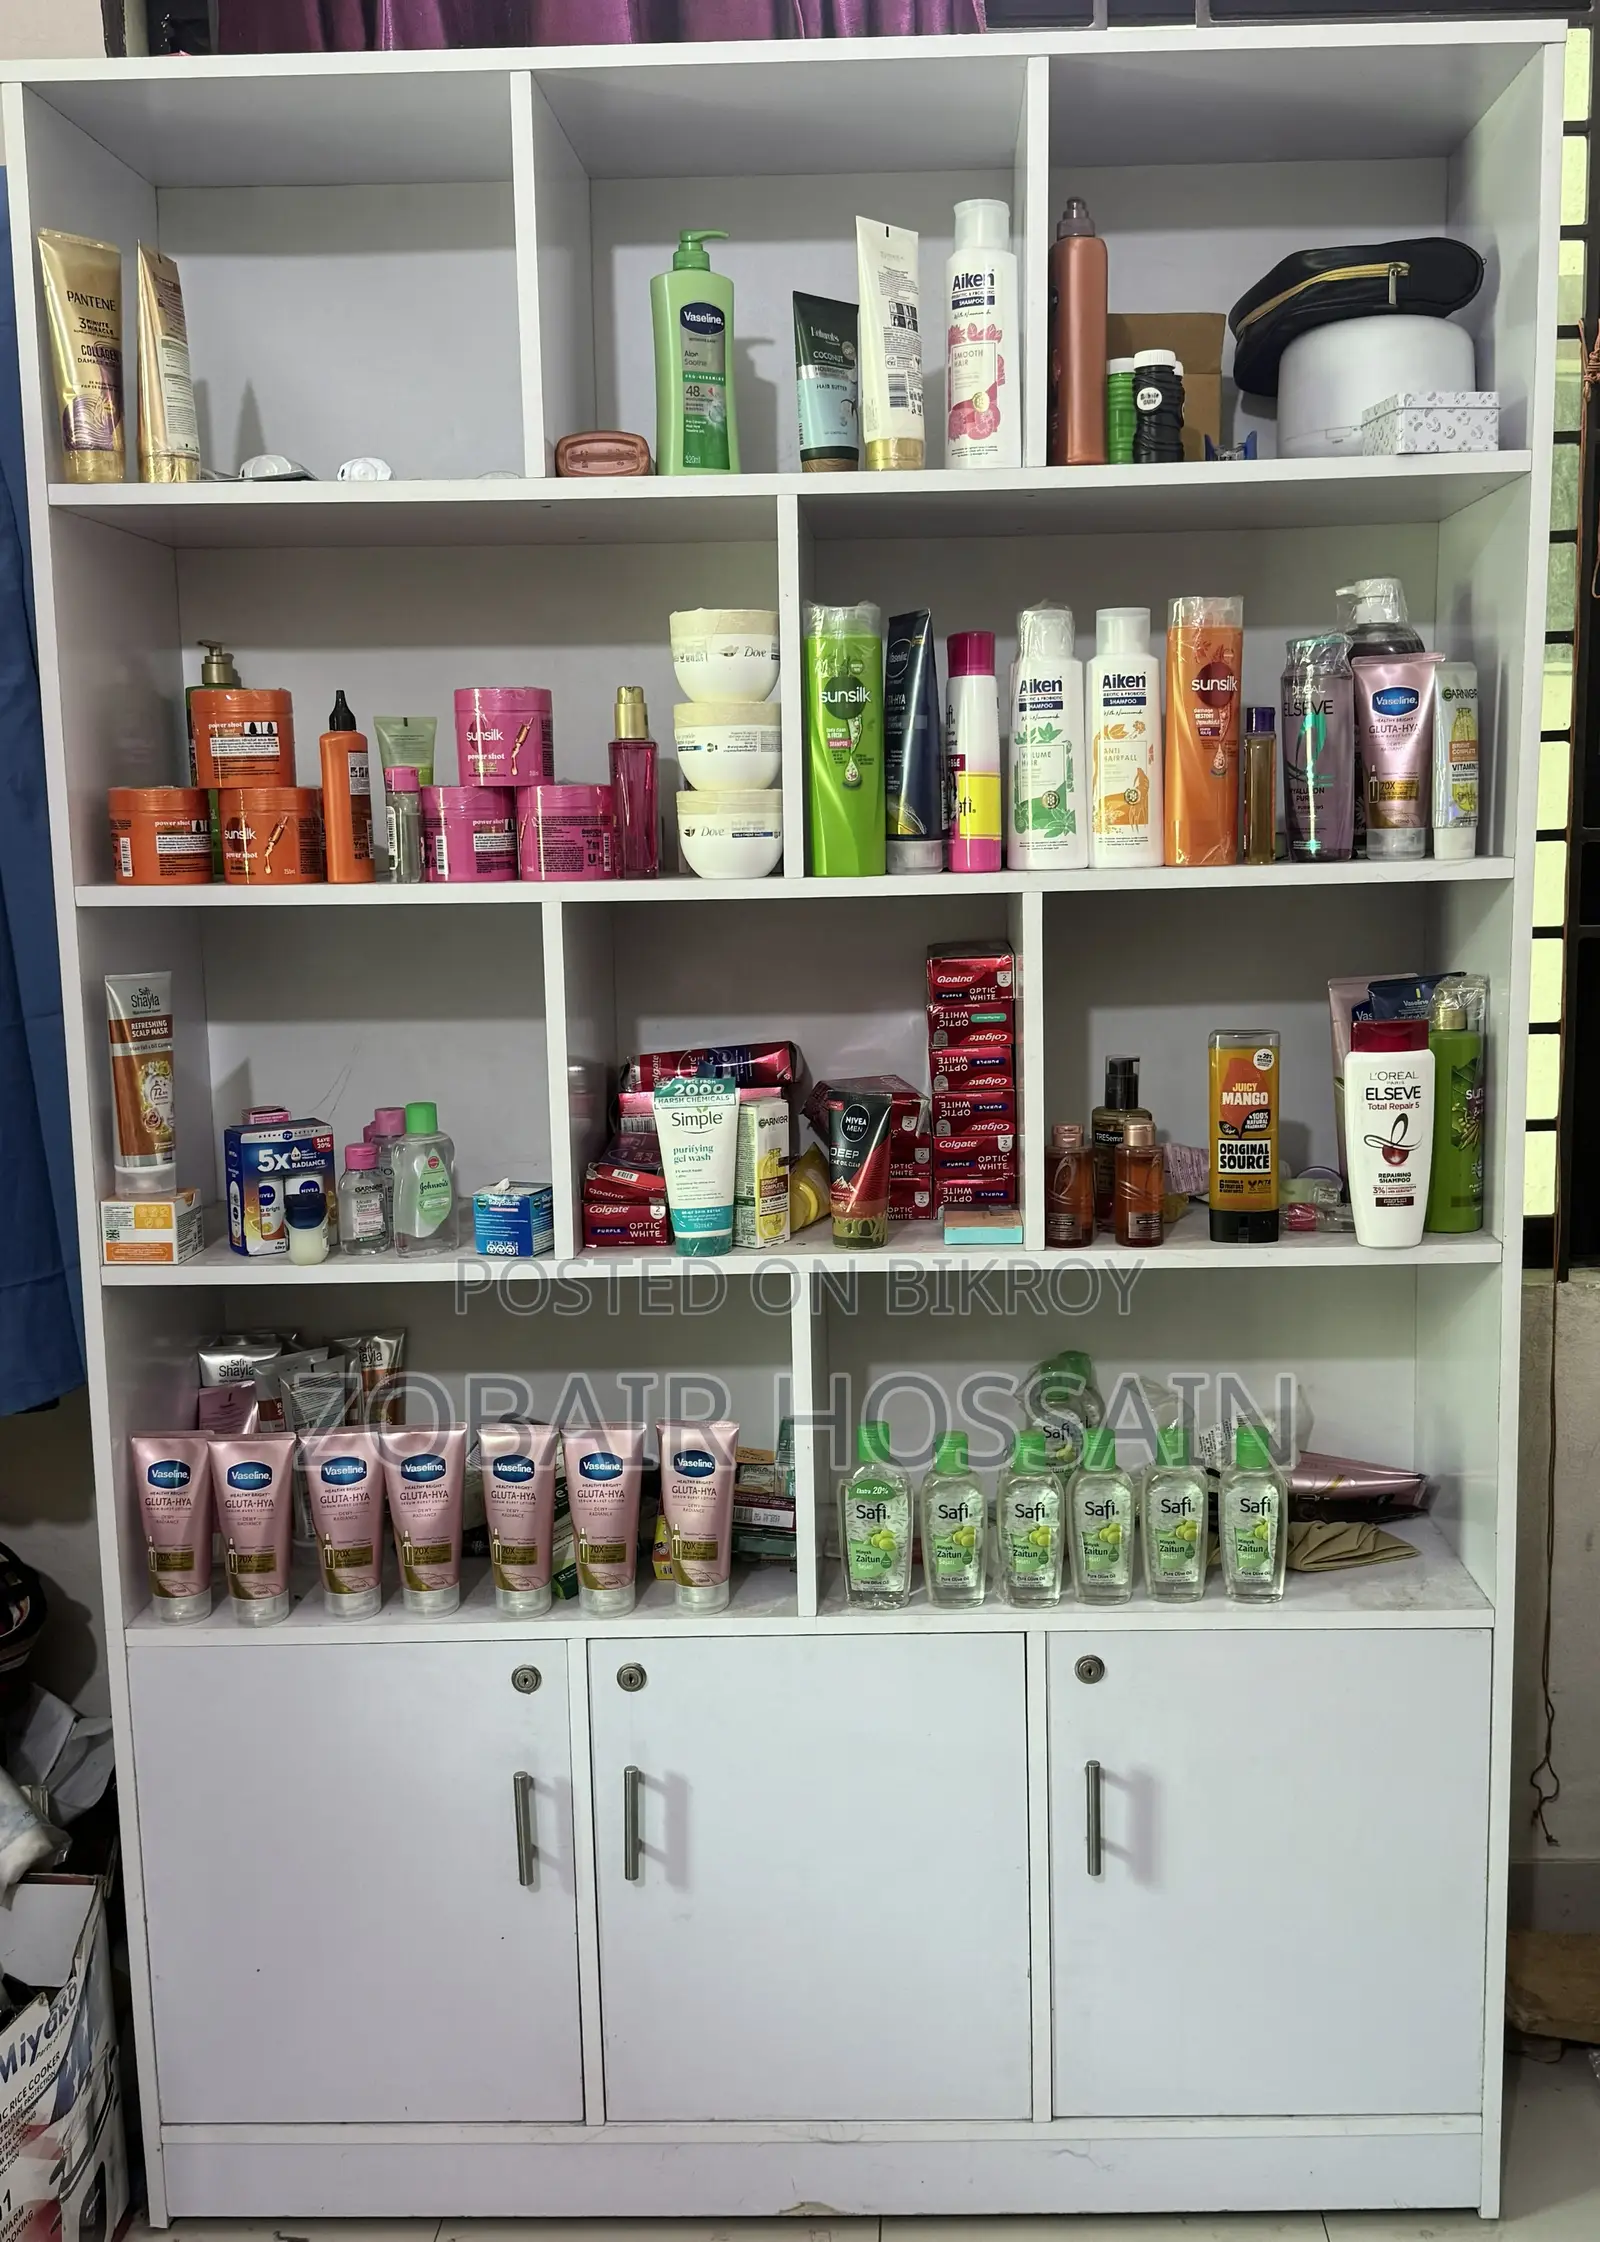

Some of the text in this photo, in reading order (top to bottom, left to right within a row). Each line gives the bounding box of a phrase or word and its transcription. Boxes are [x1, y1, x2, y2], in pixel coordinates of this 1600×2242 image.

[953, 272, 995, 291] Aiken
[67, 290, 117, 311] PANTENE
[78, 317, 87, 329] 3
[684, 311, 721, 325] Vaseline
[813, 350, 844, 363] COCONUT
[686, 386, 701, 397] 48
[744, 646, 767, 658] Dove
[1019, 678, 1062, 694] Aiken
[1102, 674, 1146, 689] Aiken
[1191, 675, 1238, 691] sunsilk
[820, 687, 871, 703] sunsilk
[1376, 697, 1415, 706] Vaseline
[208, 722, 226, 730] power
[466, 729, 504, 741] sunsilk
[154, 820, 174, 828] power
[224, 828, 257, 840] sunslk
[701, 826, 725, 837] Dove
[131, 994, 160, 1009] Shayla
[939, 1011, 969, 1019] WHITE
[131, 1020, 168, 1030] REFRESHING
[132, 1027, 168, 1038] SCALP MASK
[969, 1033, 1008, 1042] Colgate
[938, 1056, 968, 1064] WHITE
[939, 1064, 968, 1072] OPTIC
[1370, 1070, 1419, 1081] L'ORÉAL
[968, 1077, 1008, 1086] Colgate
[674, 1084, 725, 1096] 2000
[1232, 1082, 1257, 1092] JUICY
[1365, 1086, 1421, 1101] ELSEVE
[686, 1095, 730, 1103] CHEMICALS
[1222, 1092, 1269, 1106] MANGO
[941, 1101, 971, 1109] WHITE
[1389, 1102, 1414, 1111] Repair
[1415, 1101, 1420, 1109] 5
[941, 1109, 971, 1117] OPTIC
[671, 1111, 722, 1129] Simple
[758, 1115, 788, 1128] GARNIER
[845, 1116, 867, 1126] NIVEA
[846, 1125, 863, 1133] MEN
[971, 1122, 1010, 1131] Colgate
[1096, 1132, 1123, 1143] TRESemm
[673, 1144, 714, 1155] purifying
[939, 1140, 977, 1149] Colgate
[1219, 1143, 1269, 1155] ORIGINAL
[830, 1147, 860, 1158] DEEP
[673, 1153, 711, 1165] gel wash
[1219, 1155, 1269, 1170] SOURCE
[292, 1160, 326, 1169] RADIANCE
[419, 1180, 448, 1194] Johnson's
[943, 1187, 972, 1195] WHITE
[1373, 1186, 1385, 1194] 3%
[943, 1195, 972, 1203] OPTIC
[589, 1205, 629, 1216] Colgate
[629, 1222, 660, 1230] OPTIC
[629, 1230, 661, 1238] WHITE
[1043, 1423, 1069, 1440] Safi
[405, 1463, 442, 1473] Vaseline
[583, 1461, 620, 1471] Vaseline
[676, 1458, 712, 1468] Vaseline
[324, 1466, 363, 1476] Vaseline
[496, 1463, 532, 1474] Vaseline
[151, 1469, 187, 1479] Vaseline
[231, 1470, 269, 1480] Vaseline
[577, 1490, 625, 1498] GLUTA-HYA
[671, 1486, 717, 1496] GLUTA-HYA
[872, 1486, 889, 1494] 20%
[320, 1493, 370, 1504] GLUTA-HYA
[400, 1491, 449, 1501] GLUTA-HYA
[491, 1490, 536, 1501] GLUTA-HYA
[145, 1497, 192, 1507] GLUTA-HYA
[225, 1499, 274, 1509] GLUTA-HYA
[1161, 1496, 1191, 1516] Safi
[1240, 1496, 1271, 1516] Safi
[856, 1503, 887, 1522] Safi
[938, 1502, 969, 1521] Safi
[1015, 1502, 1046, 1521] Safi
[1085, 1500, 1116, 1519] Safi
[1084, 1547, 1108, 1556] Zaitun
[1160, 1544, 1185, 1553] Zaitun
[1238, 1544, 1263, 1553] Zaitun
[856, 1554, 881, 1563] Zaitun
[937, 1549, 962, 1559] Zaitun
[1013, 1549, 1038, 1559] Zaitun
[9, 2051, 61, 2113] RICE COOKER
[0, 2205, 25, 2239] WARM
